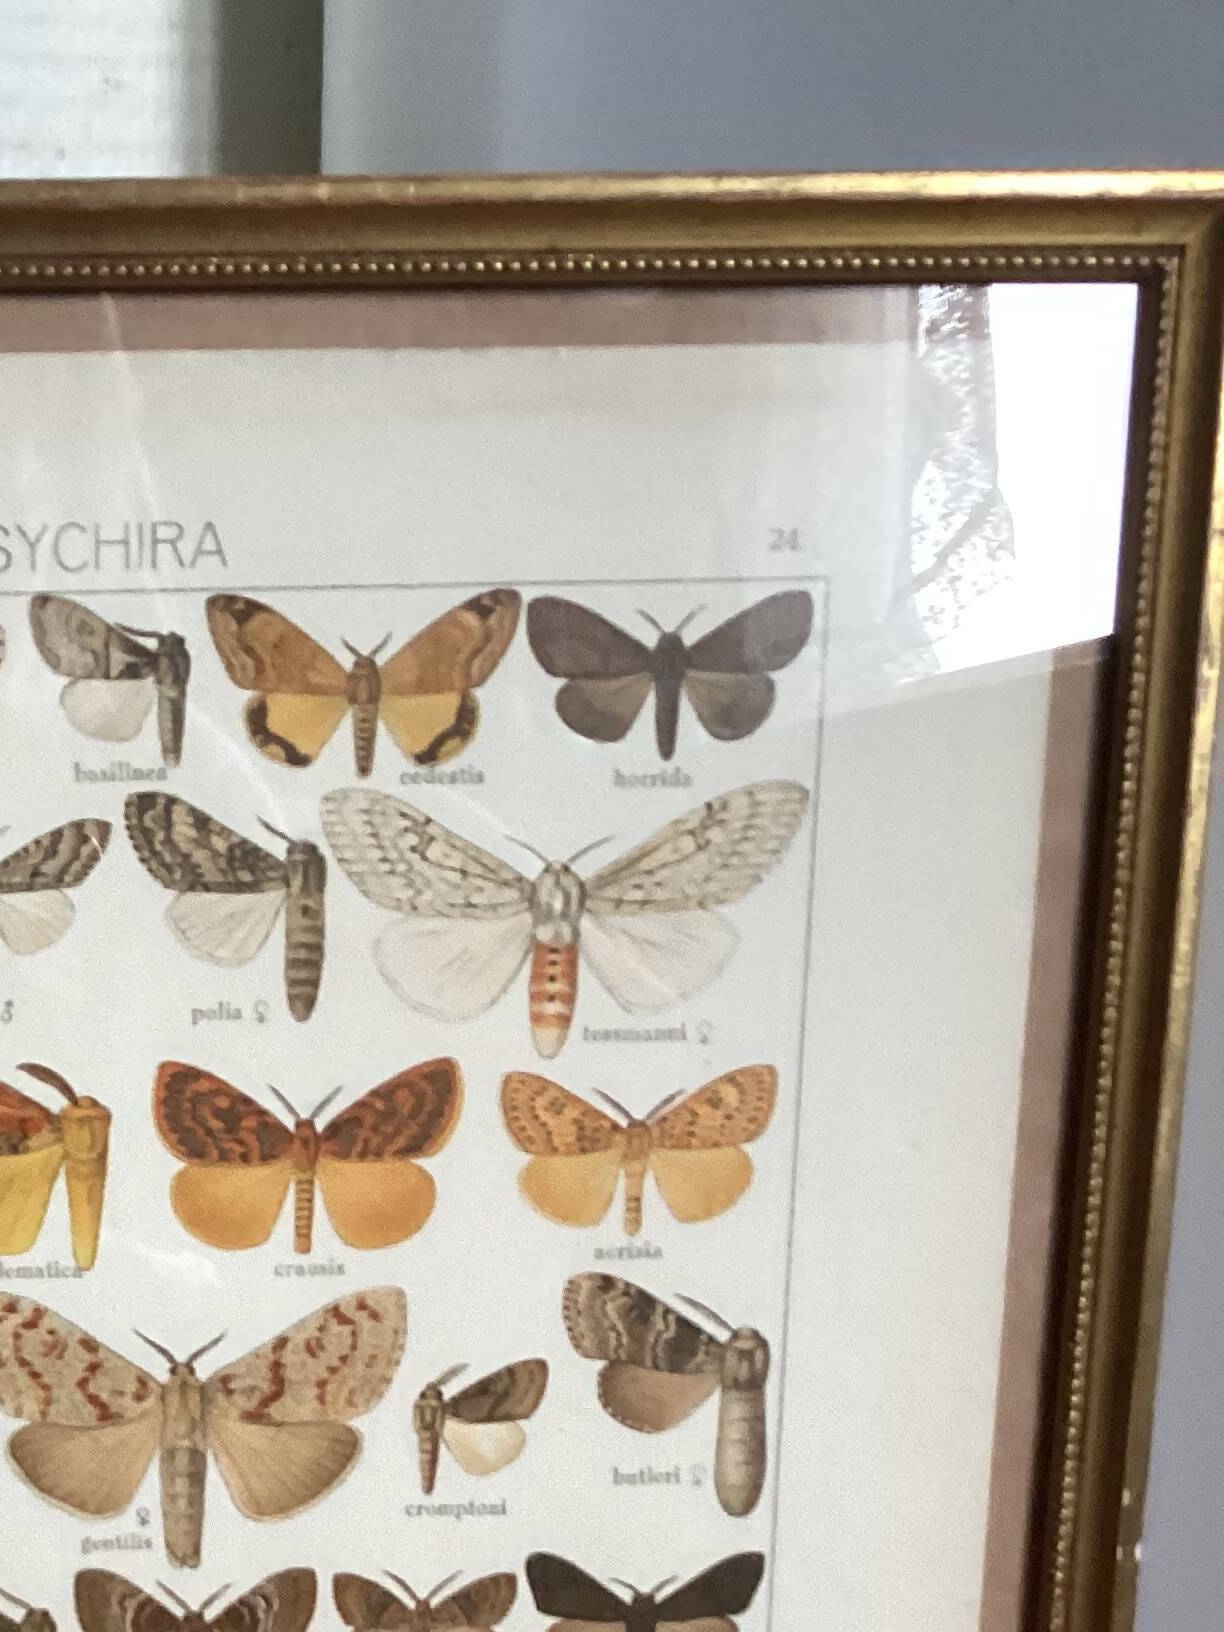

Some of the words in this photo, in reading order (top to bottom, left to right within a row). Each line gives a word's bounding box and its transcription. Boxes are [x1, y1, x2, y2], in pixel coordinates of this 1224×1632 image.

[614, 768, 691, 787] horrida
[192, 1002, 242, 1025] polia
[613, 1467, 680, 1485] butleri
[405, 1500, 506, 1520] cromptoni
[81, 1534, 152, 1555] gentilis
